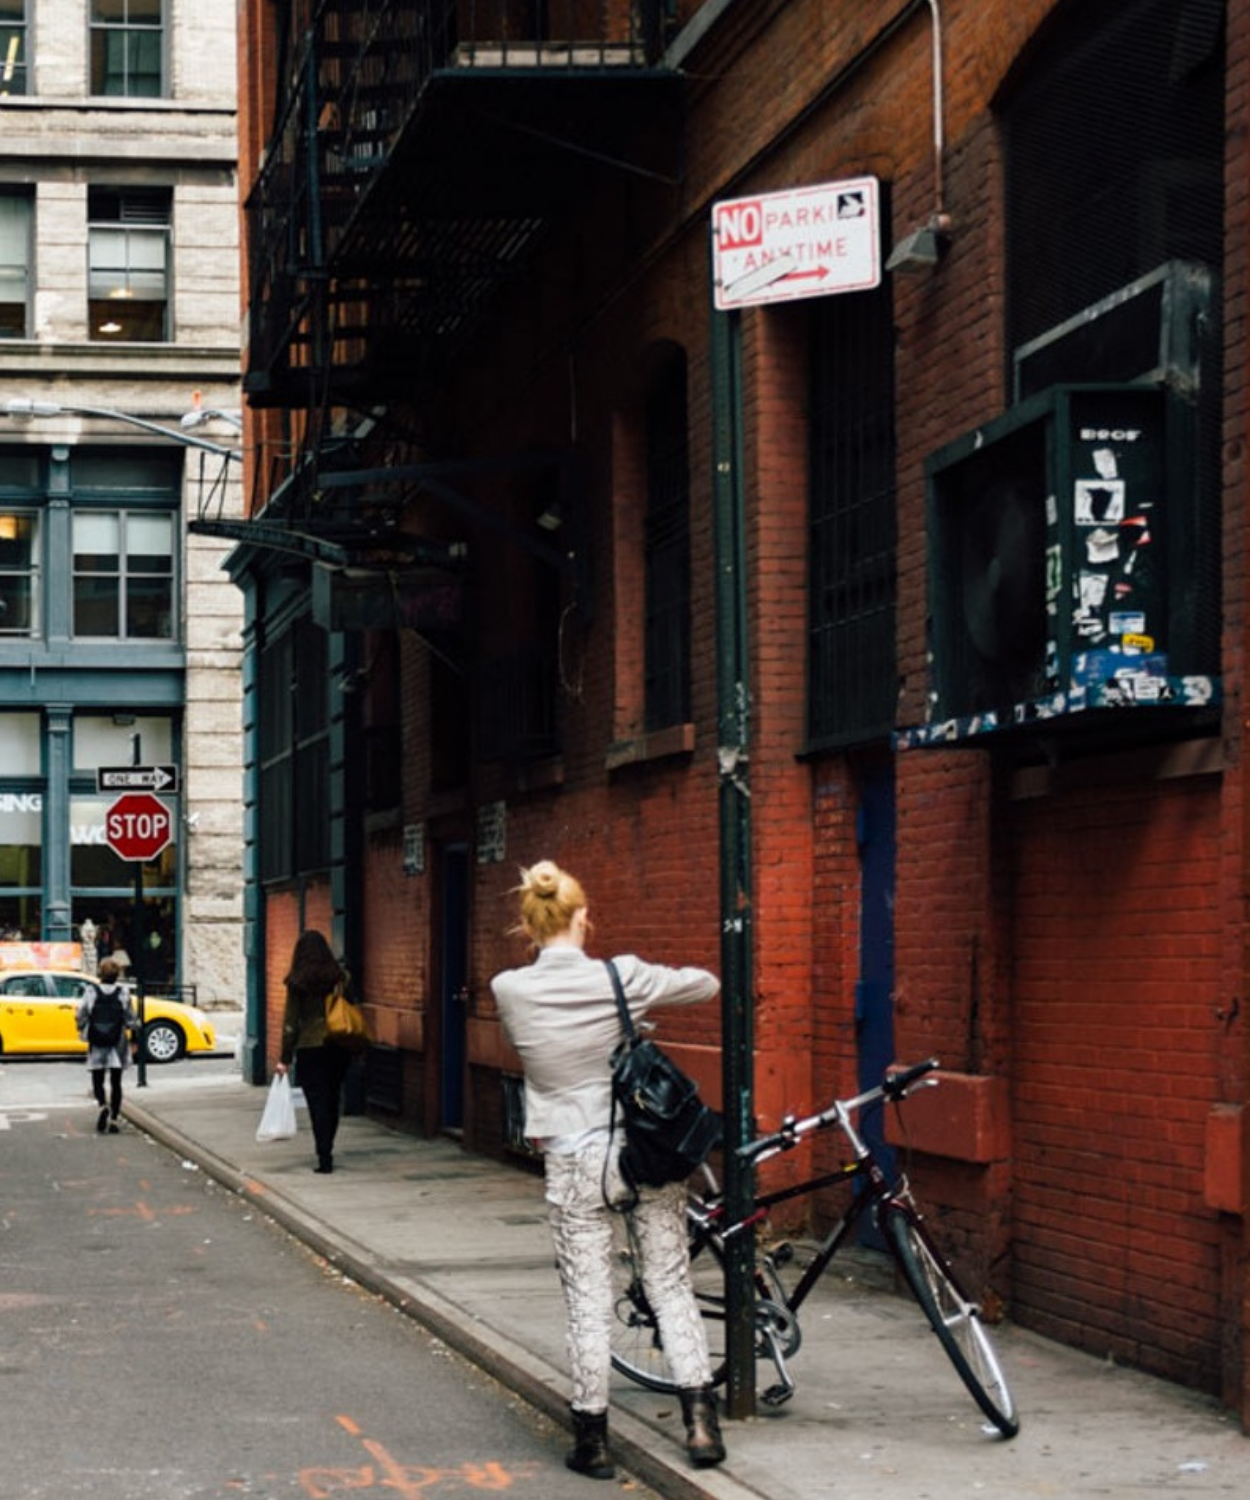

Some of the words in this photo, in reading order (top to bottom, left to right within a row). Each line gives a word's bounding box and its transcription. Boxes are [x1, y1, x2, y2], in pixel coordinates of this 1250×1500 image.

[720, 205, 760, 244] NO
[108, 775, 130, 785] ONE
[141, 775, 164, 784] WAY
[109, 813, 167, 839] STOP
